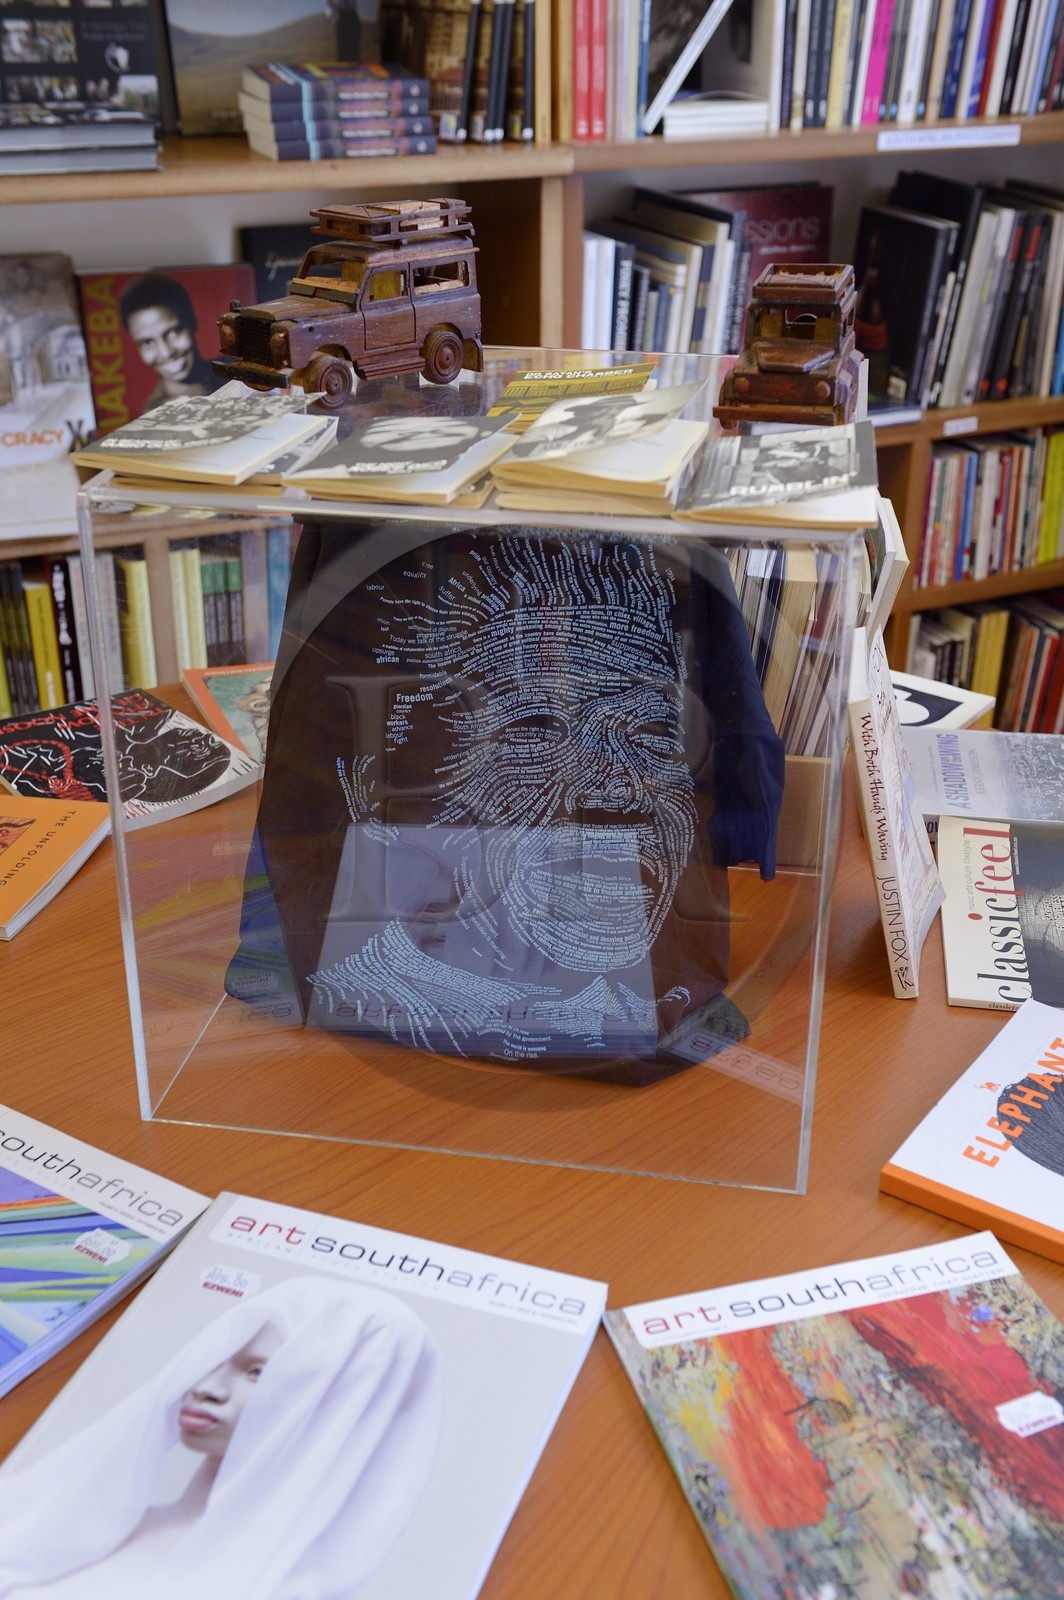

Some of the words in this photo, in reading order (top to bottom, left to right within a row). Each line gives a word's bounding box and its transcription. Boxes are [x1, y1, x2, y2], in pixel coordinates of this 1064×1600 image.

[491, 627, 514, 637] mighty
[609, 622, 629, 631] more
[631, 624, 664, 642] freedom!
[376, 656, 399, 664] african
[611, 639, 653, 660] suppression
[397, 692, 433, 702] Freedom
[860, 712, 875, 747] With
[936, 734, 961, 756] WING
[864, 747, 880, 777] Both
[940, 762, 969, 802] SHADOW
[869, 778, 884, 815] Hands
[55, 810, 77, 827] THE
[876, 815, 891, 861] Waving
[0, 831, 56, 886] UNFOLDING
[877, 875, 902, 926] JUSTIN
[963, 827, 1033, 1002] classicfeel
[888, 929, 909, 962] FOX
[514, 1049, 525, 1057] the
[74, 1244, 108, 1264] EZWENI
[202, 1280, 244, 1298] EZWENI
